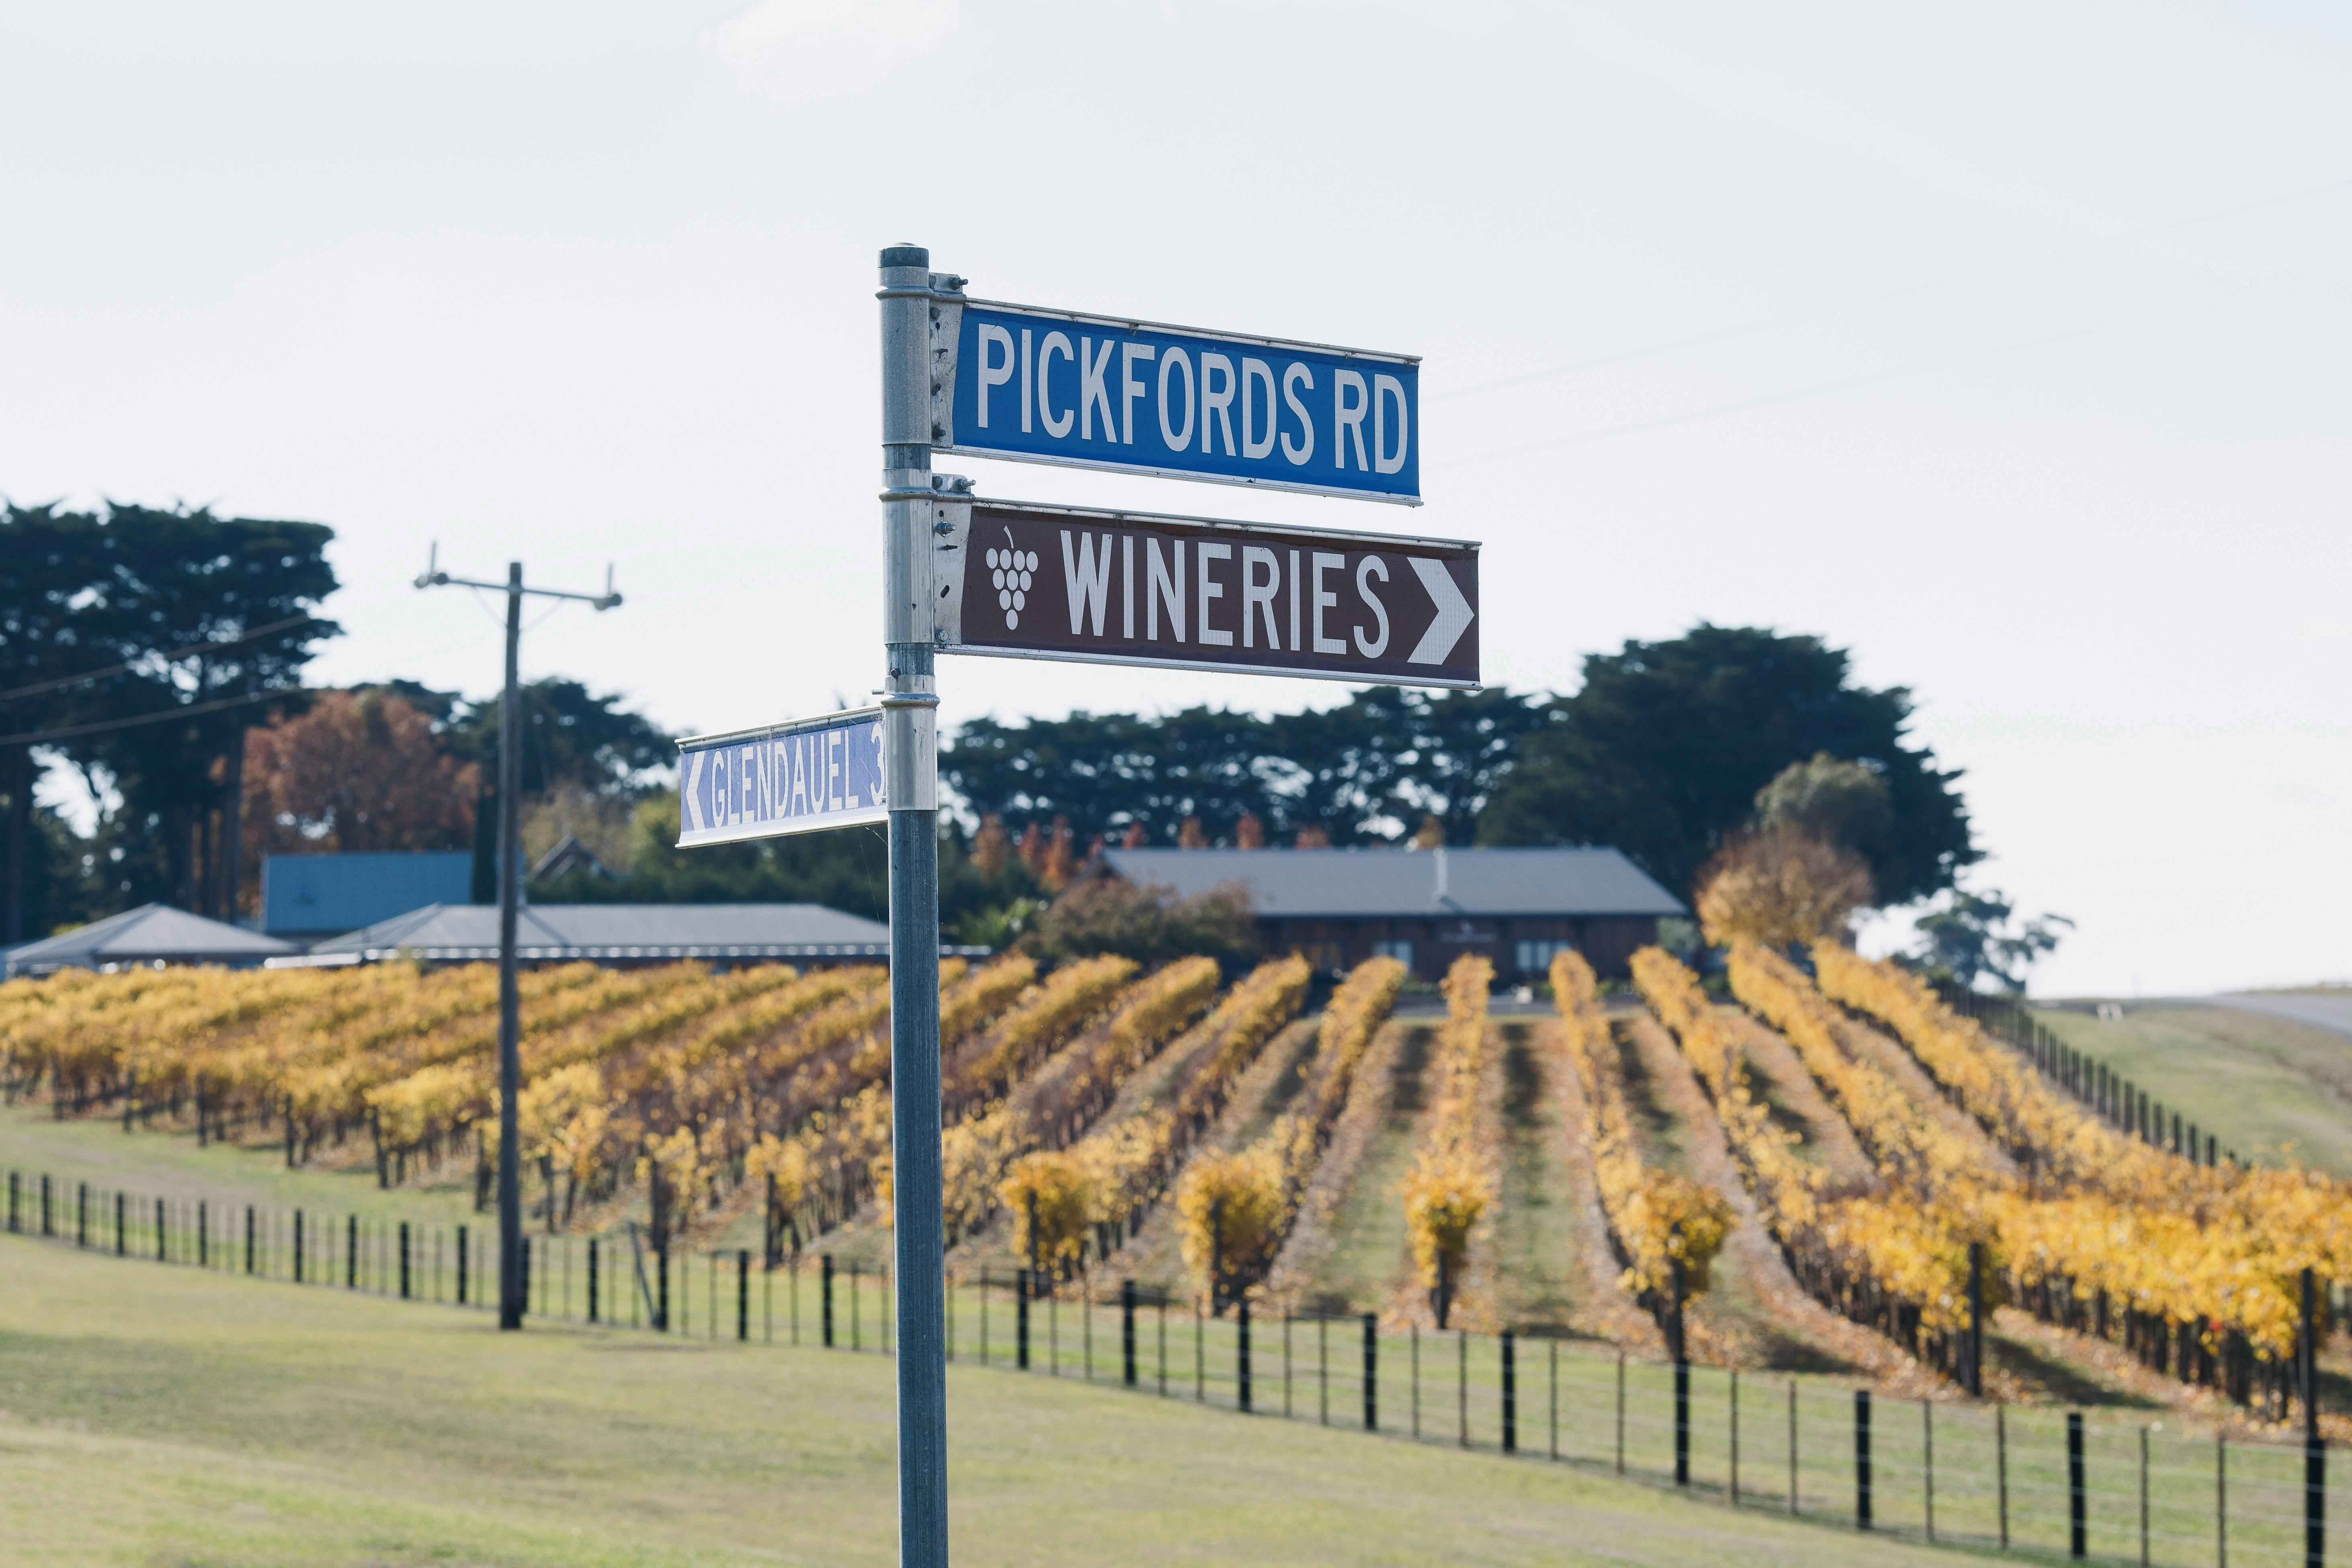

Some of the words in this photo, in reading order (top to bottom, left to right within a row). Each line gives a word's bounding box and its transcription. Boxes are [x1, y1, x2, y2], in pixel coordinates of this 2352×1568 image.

[978, 323, 1314, 466] PICKFORDS
[1335, 369, 1408, 474] RD
[1061, 530, 1388, 658] WINERIES
[712, 729, 858, 828] GLENDAUEL
[870, 723, 885, 806] 3
